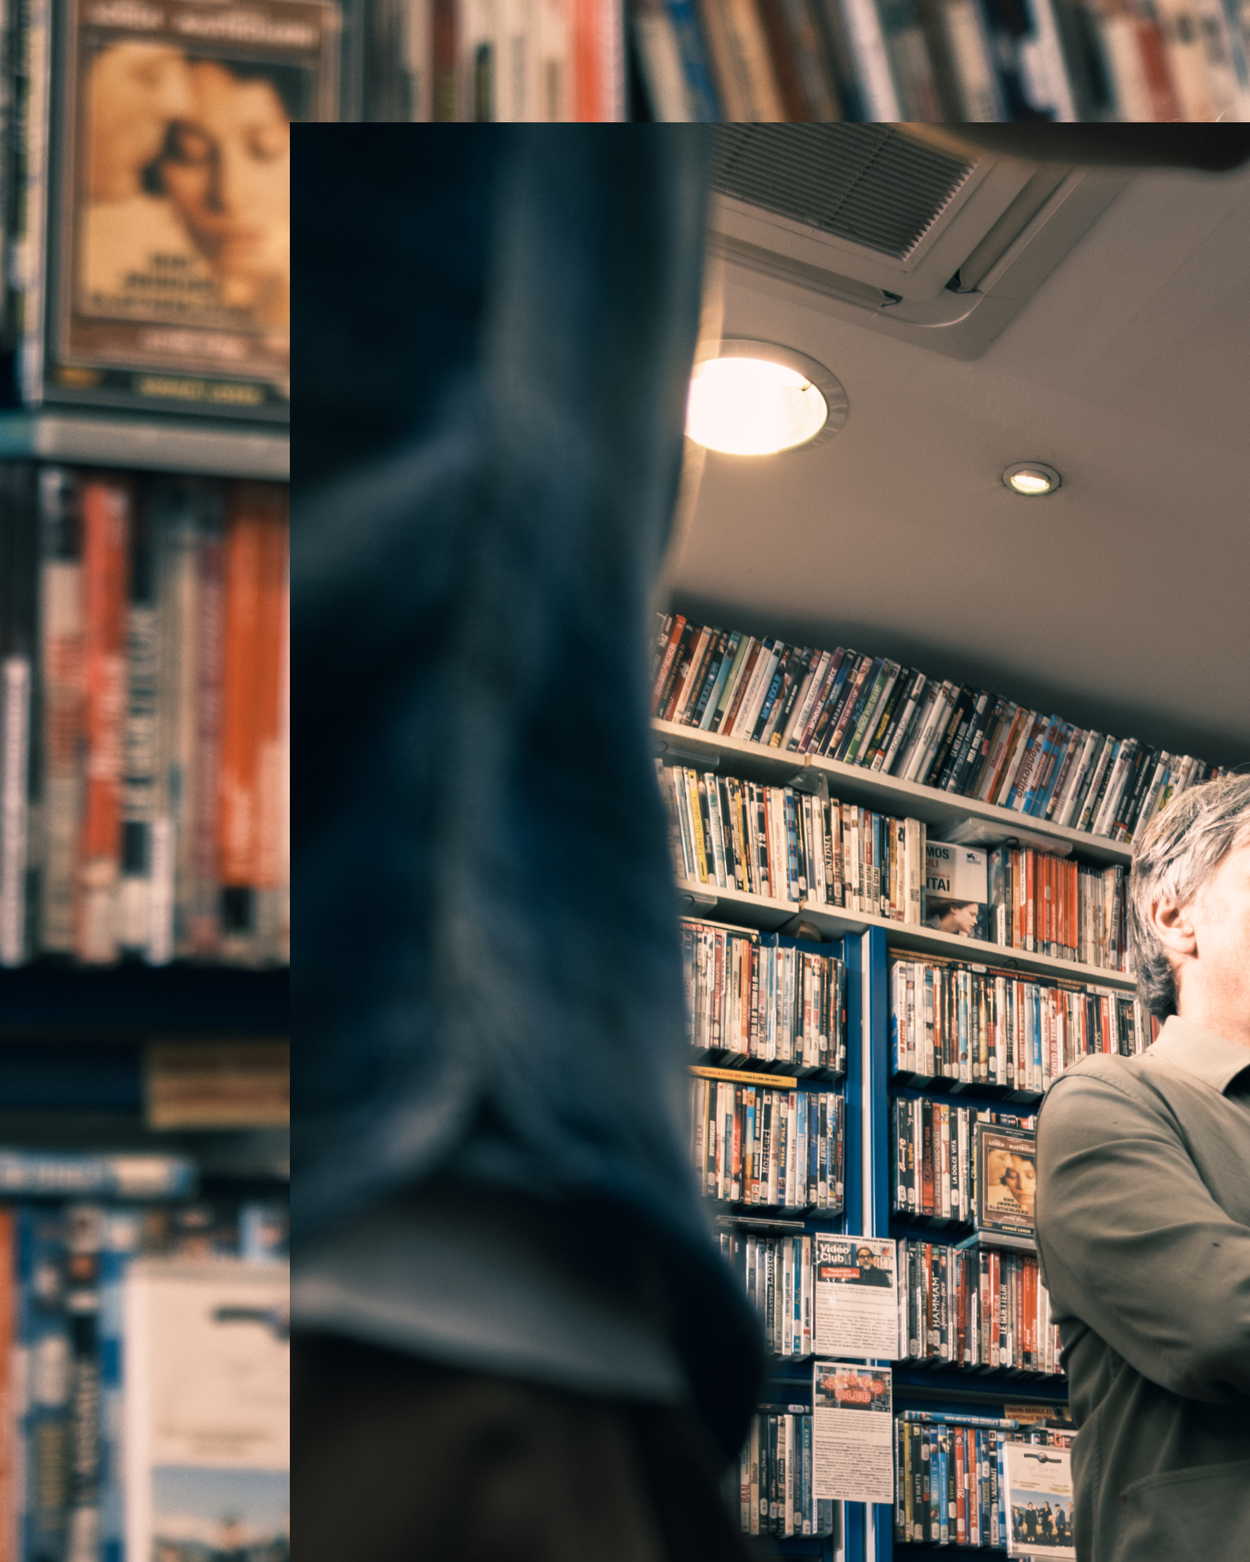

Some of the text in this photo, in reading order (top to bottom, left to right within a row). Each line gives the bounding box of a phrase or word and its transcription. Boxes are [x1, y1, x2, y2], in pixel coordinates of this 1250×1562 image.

[760, 673, 782, 719] MON IDOLE
[829, 699, 844, 725] MADAME
[1013, 740, 1043, 798] Mondovino
[762, 1128, 770, 1174] Morituri
[820, 1243, 851, 1255] Vidéo
[820, 1253, 845, 1263] Club
[932, 1277, 940, 1328] HAMMAM
[824, 1373, 885, 1395] VIDEO
[836, 1389, 871, 1402] CLUB
[779, 1459, 787, 1484] ULZHAN
[741, 1484, 750, 1503] BAAL
[956, 1488, 965, 1499] 20
